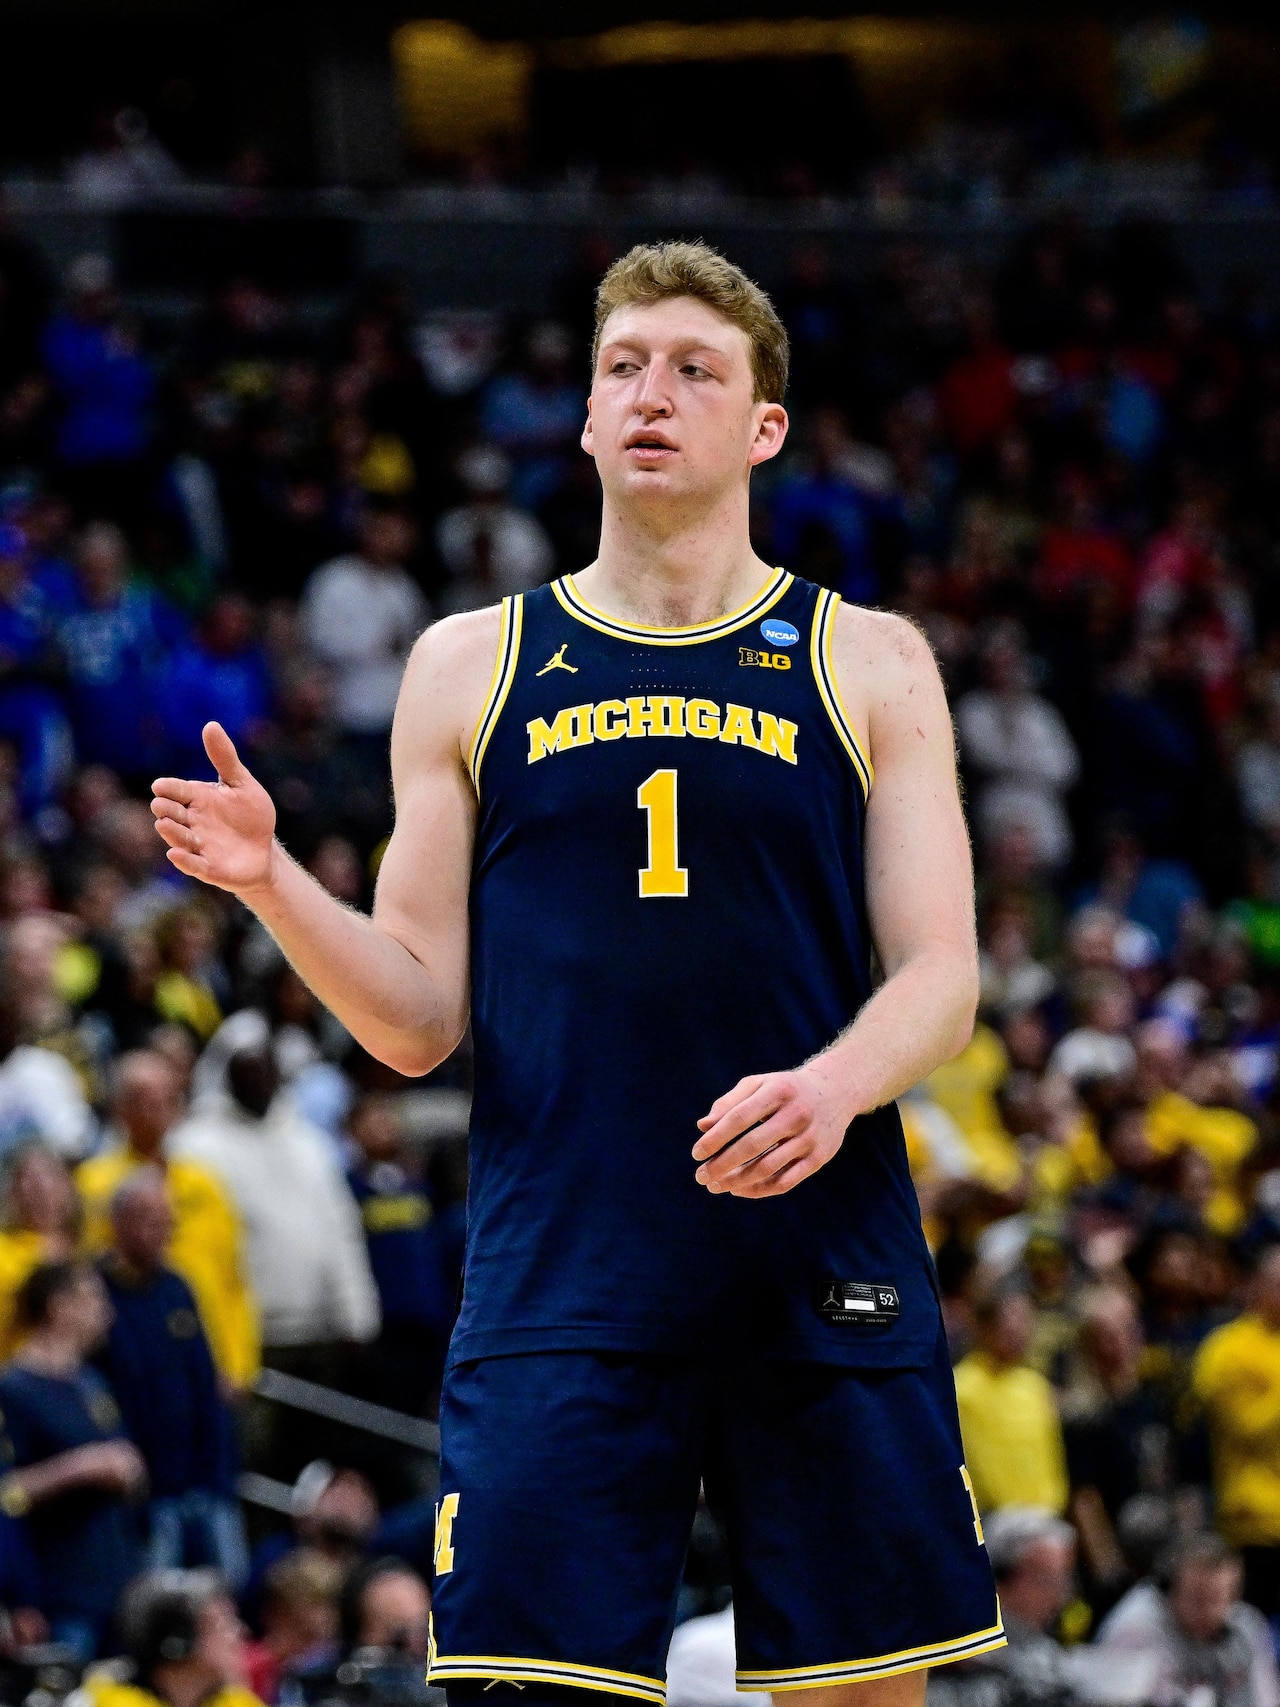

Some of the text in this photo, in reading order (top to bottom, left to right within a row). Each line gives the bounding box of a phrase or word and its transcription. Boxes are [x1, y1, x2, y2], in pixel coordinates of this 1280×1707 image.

[766, 629, 797, 641] NCAA
[526, 696, 798, 766] MICHIGAN
[637, 768, 688, 898] 1
[879, 1293, 895, 1306] 52
